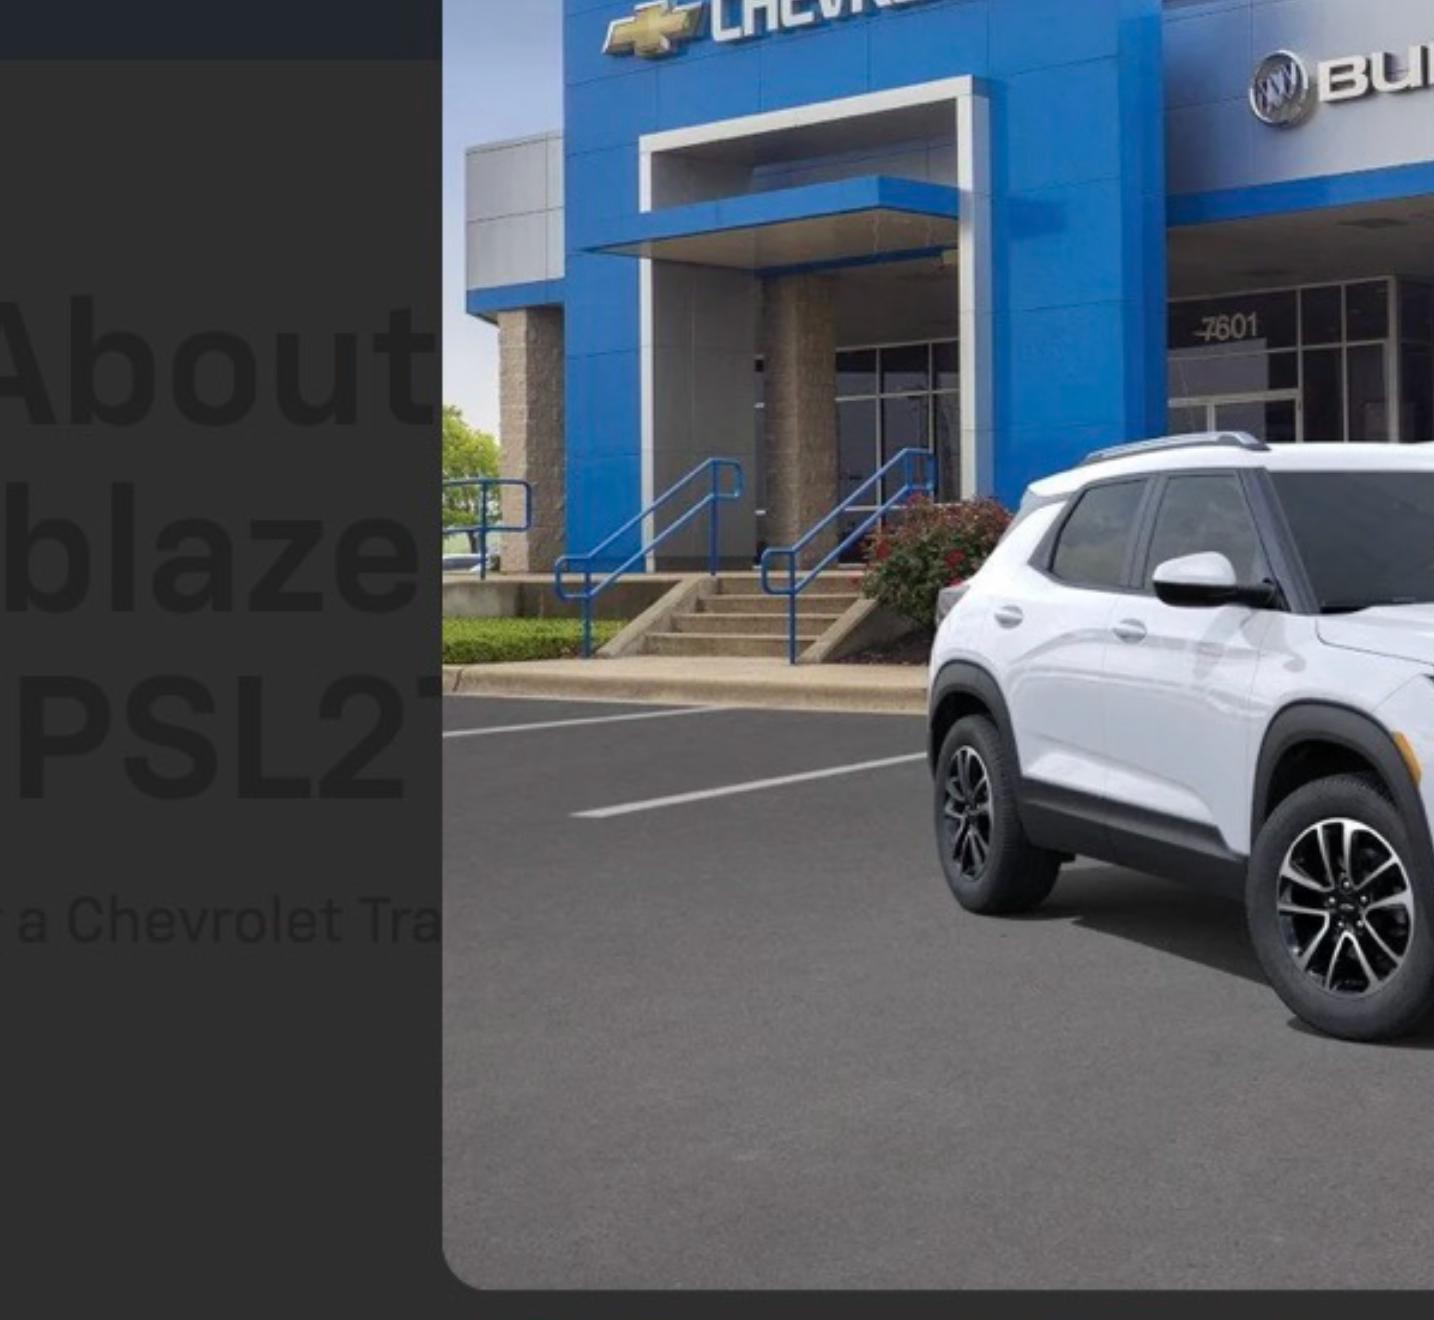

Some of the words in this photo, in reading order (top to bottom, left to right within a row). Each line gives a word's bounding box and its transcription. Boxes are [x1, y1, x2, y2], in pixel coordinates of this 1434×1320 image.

[1201, 312, 1259, 342] 7601
[5, 481, 420, 614] blaze
[19, 673, 441, 800] PSL2
[18, 907, 48, 944] a
[67, 893, 343, 944] Chevrolet
